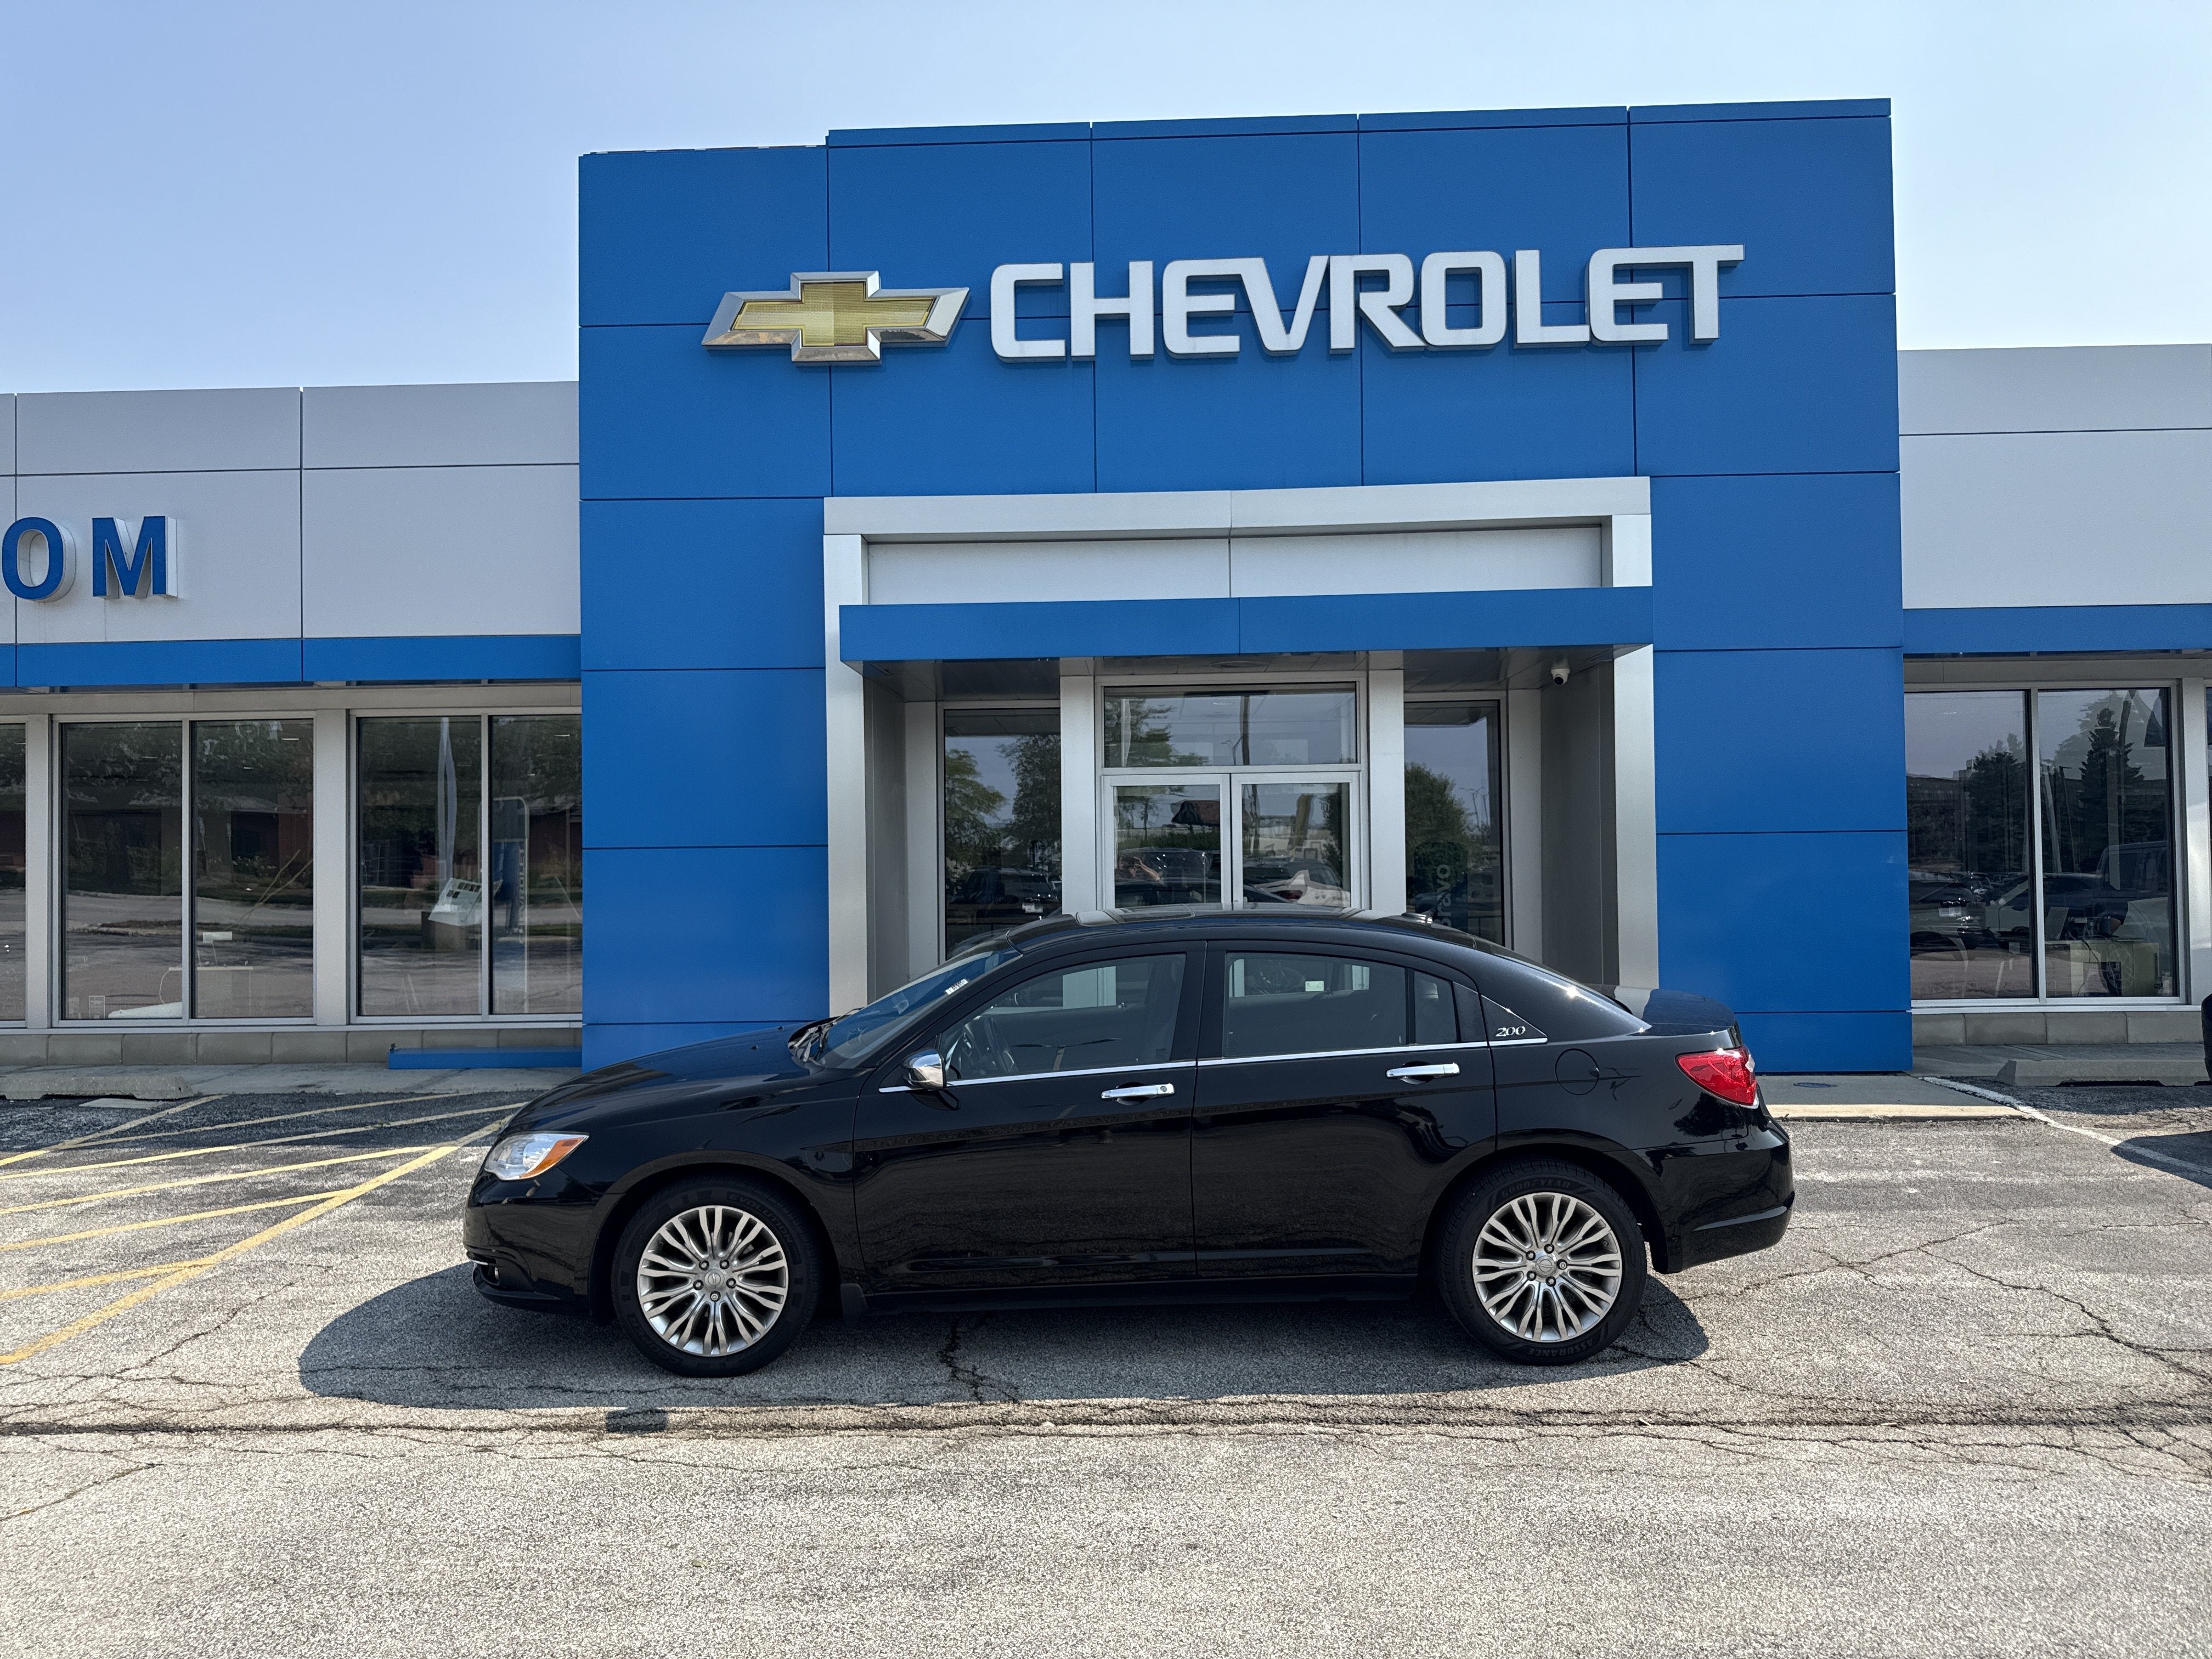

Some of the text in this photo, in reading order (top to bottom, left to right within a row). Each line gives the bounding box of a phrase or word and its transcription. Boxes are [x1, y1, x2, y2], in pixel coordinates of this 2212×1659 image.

[990, 244, 1745, 361] CHEVROLET
[1496, 1026, 1526, 1037] 200
[1501, 1179, 1571, 1198] GOODYEAR
[729, 1194, 795, 1243] EVOLUTION
[1527, 1338, 1593, 1357] ASSURANCE
